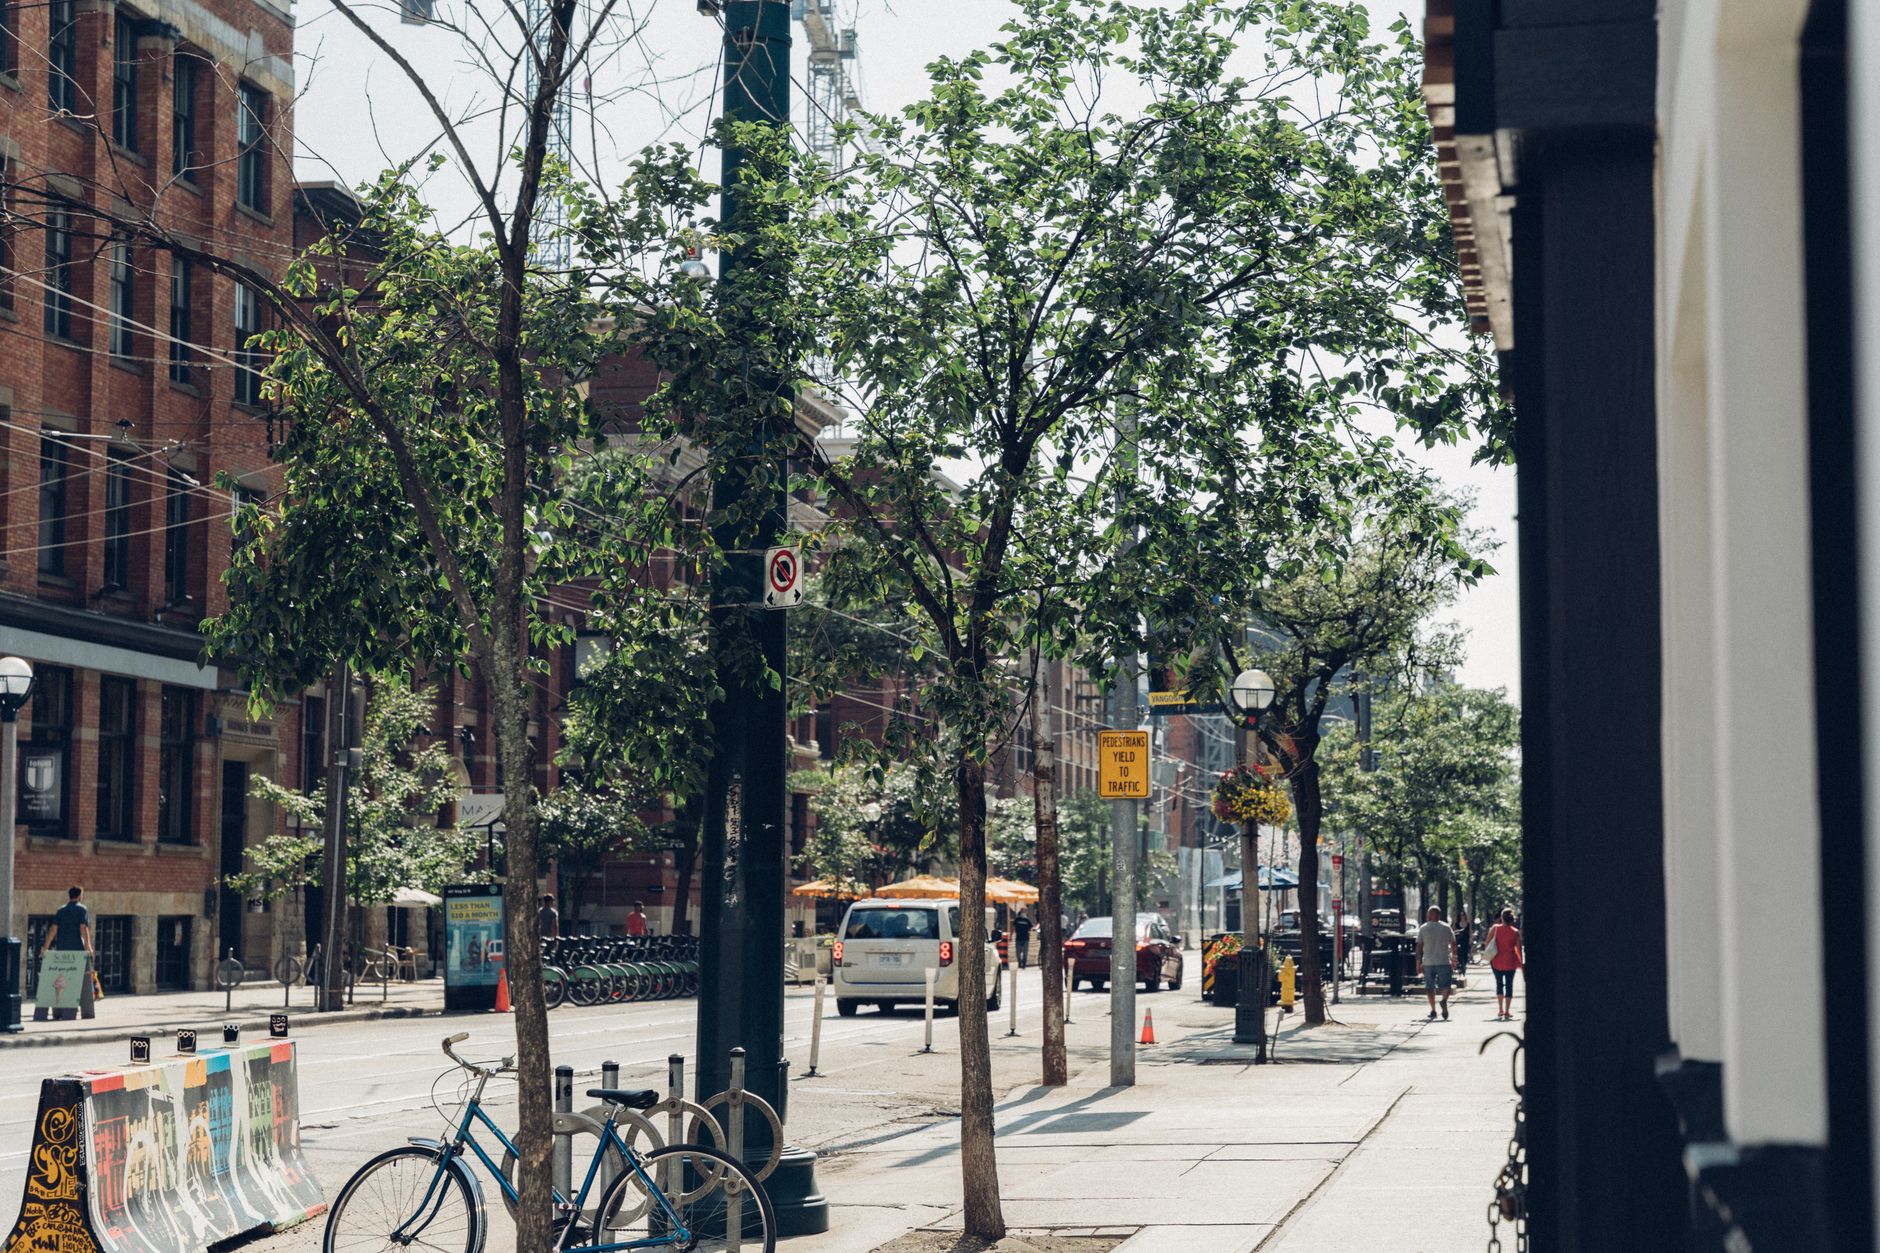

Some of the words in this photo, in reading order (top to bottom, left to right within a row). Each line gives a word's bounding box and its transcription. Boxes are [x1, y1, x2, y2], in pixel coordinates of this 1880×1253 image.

[1102, 736, 1145, 747] PEDESTRIANS
[1112, 751, 1136, 763] YIELD
[1119, 766, 1129, 778] TO
[1108, 781, 1140, 793] TRAFFIC
